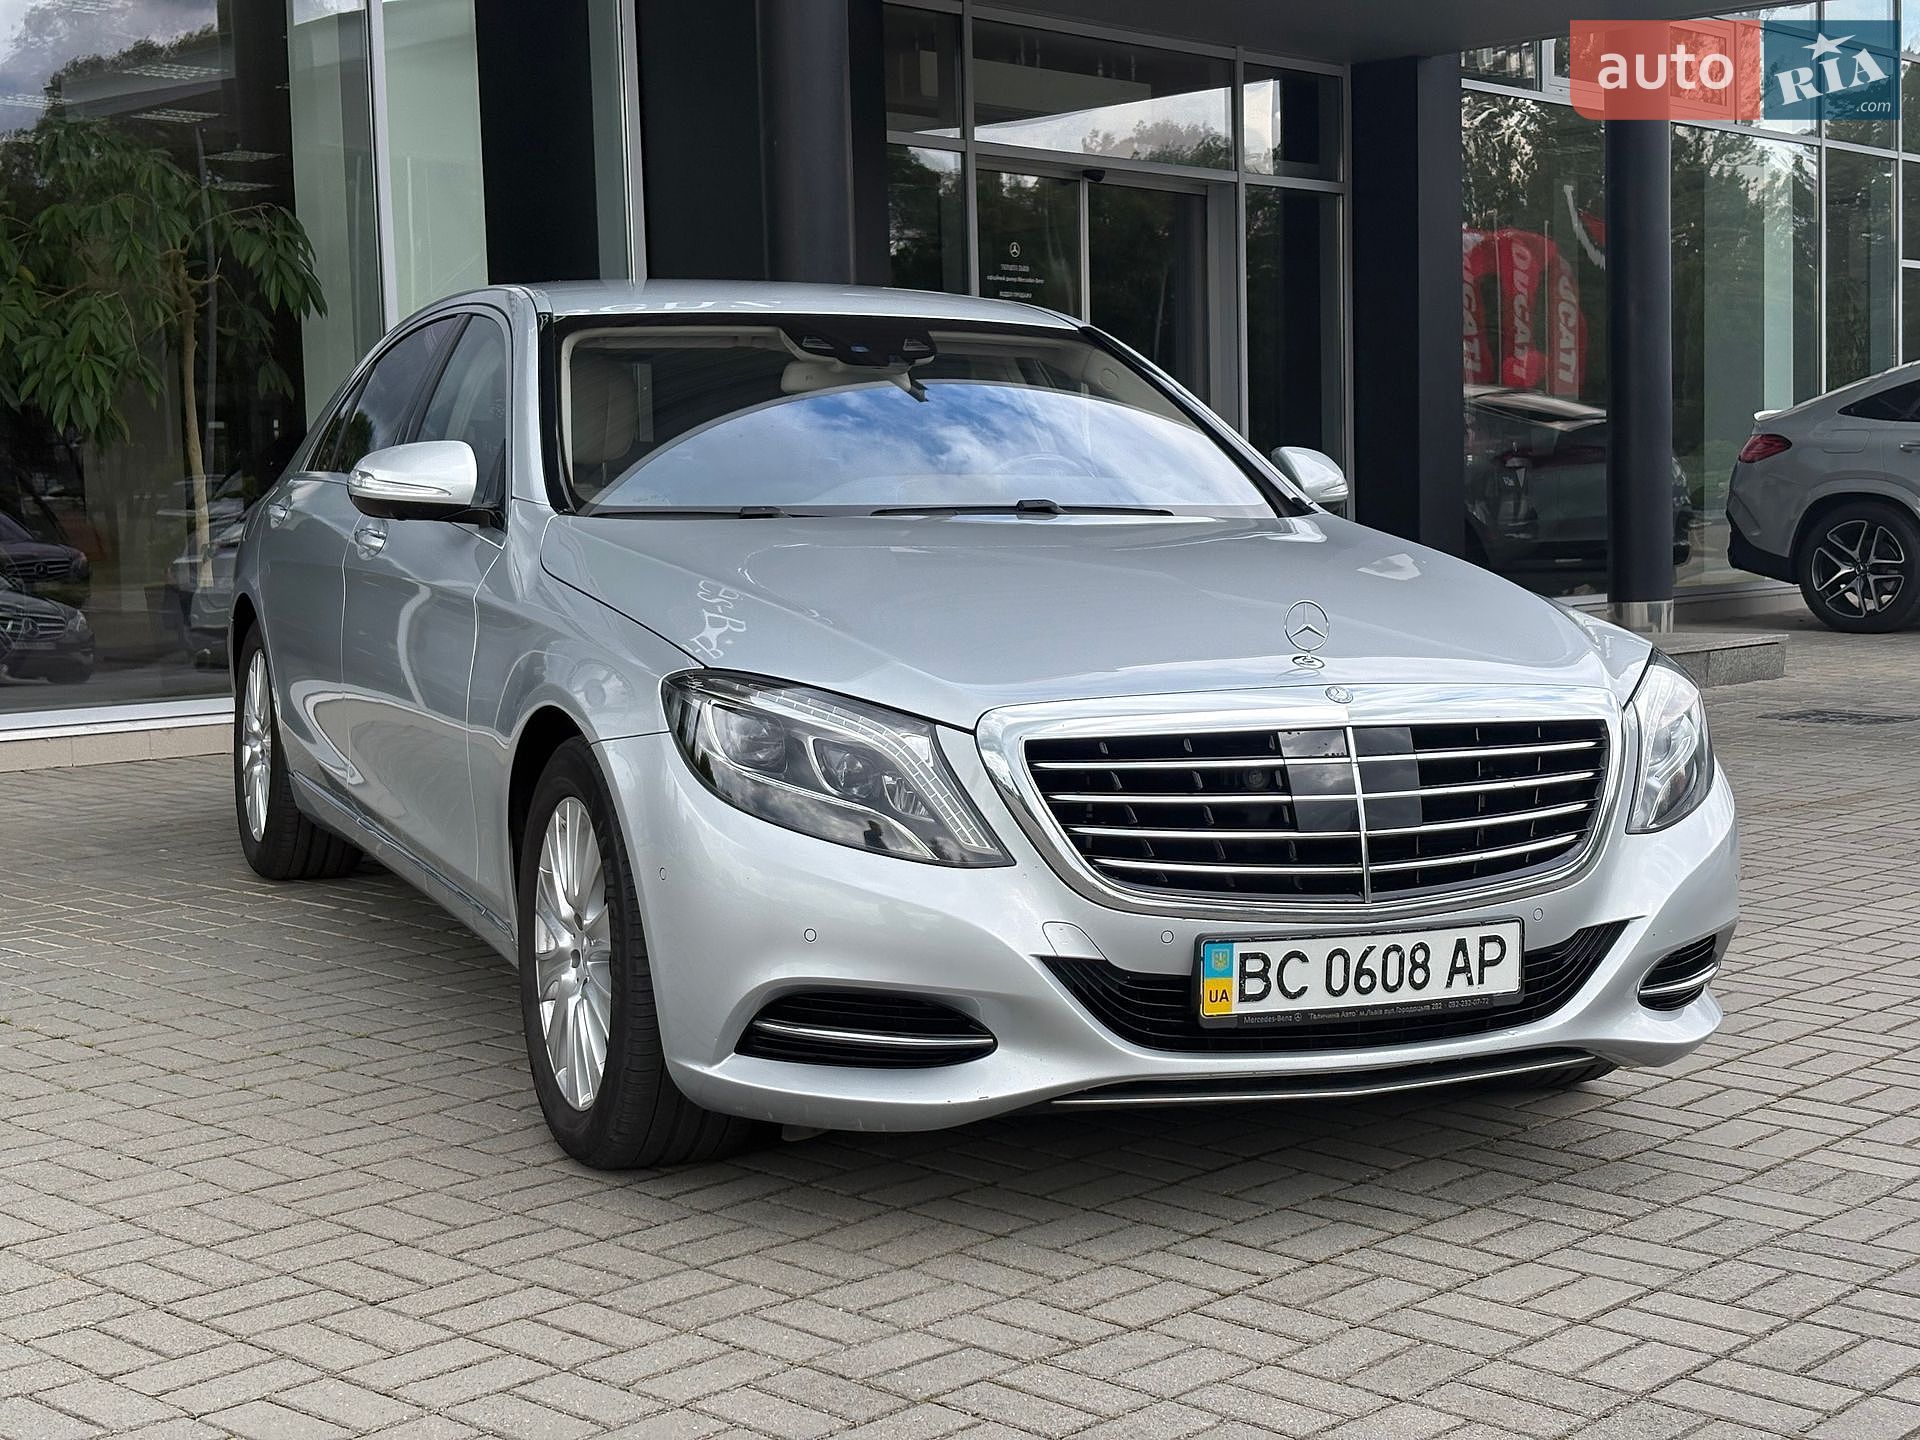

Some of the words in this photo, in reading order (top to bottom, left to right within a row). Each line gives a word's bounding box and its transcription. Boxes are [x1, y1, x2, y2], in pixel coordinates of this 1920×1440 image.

[1511, 242, 1532, 380] DUCATI
[1238, 950, 1309, 1003] BC
[1325, 941, 1431, 997] 0608
[1445, 934, 1507, 989] AP
[1209, 989, 1229, 1003] UA
[1243, 1013, 1293, 1024] Mercedes-Benz
